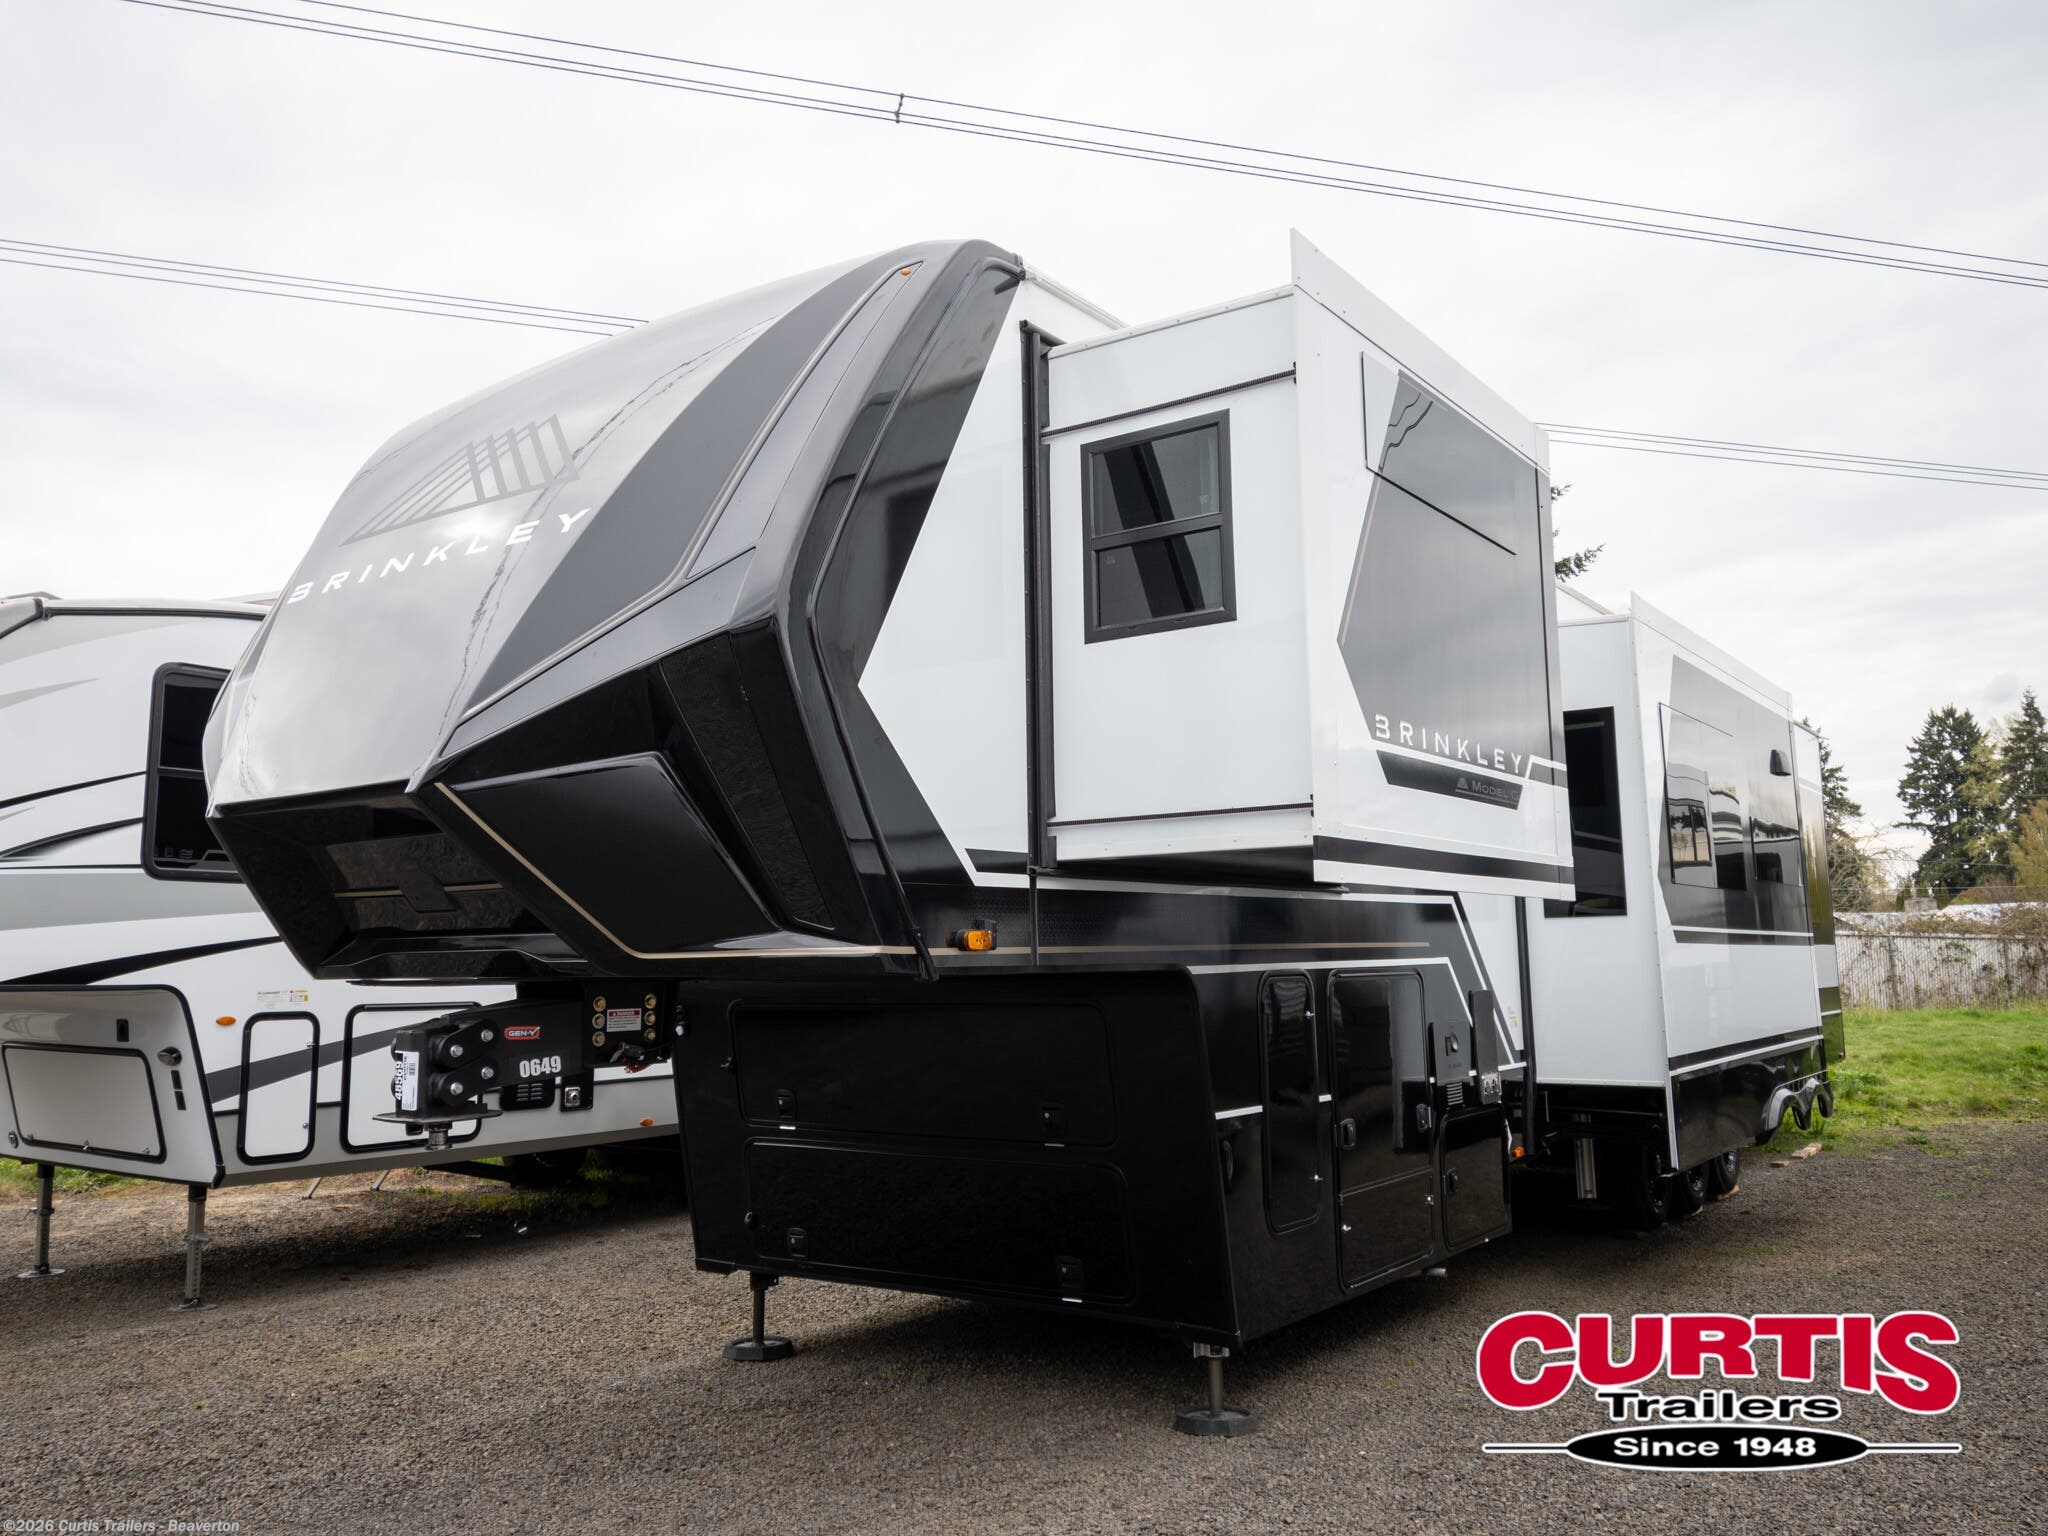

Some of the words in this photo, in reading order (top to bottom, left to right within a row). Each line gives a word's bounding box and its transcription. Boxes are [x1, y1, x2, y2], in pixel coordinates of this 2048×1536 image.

[287, 508, 591, 604] BRINKLEY
[1375, 714, 1522, 774] BRINKLEY
[519, 1055, 562, 1078] 0649
